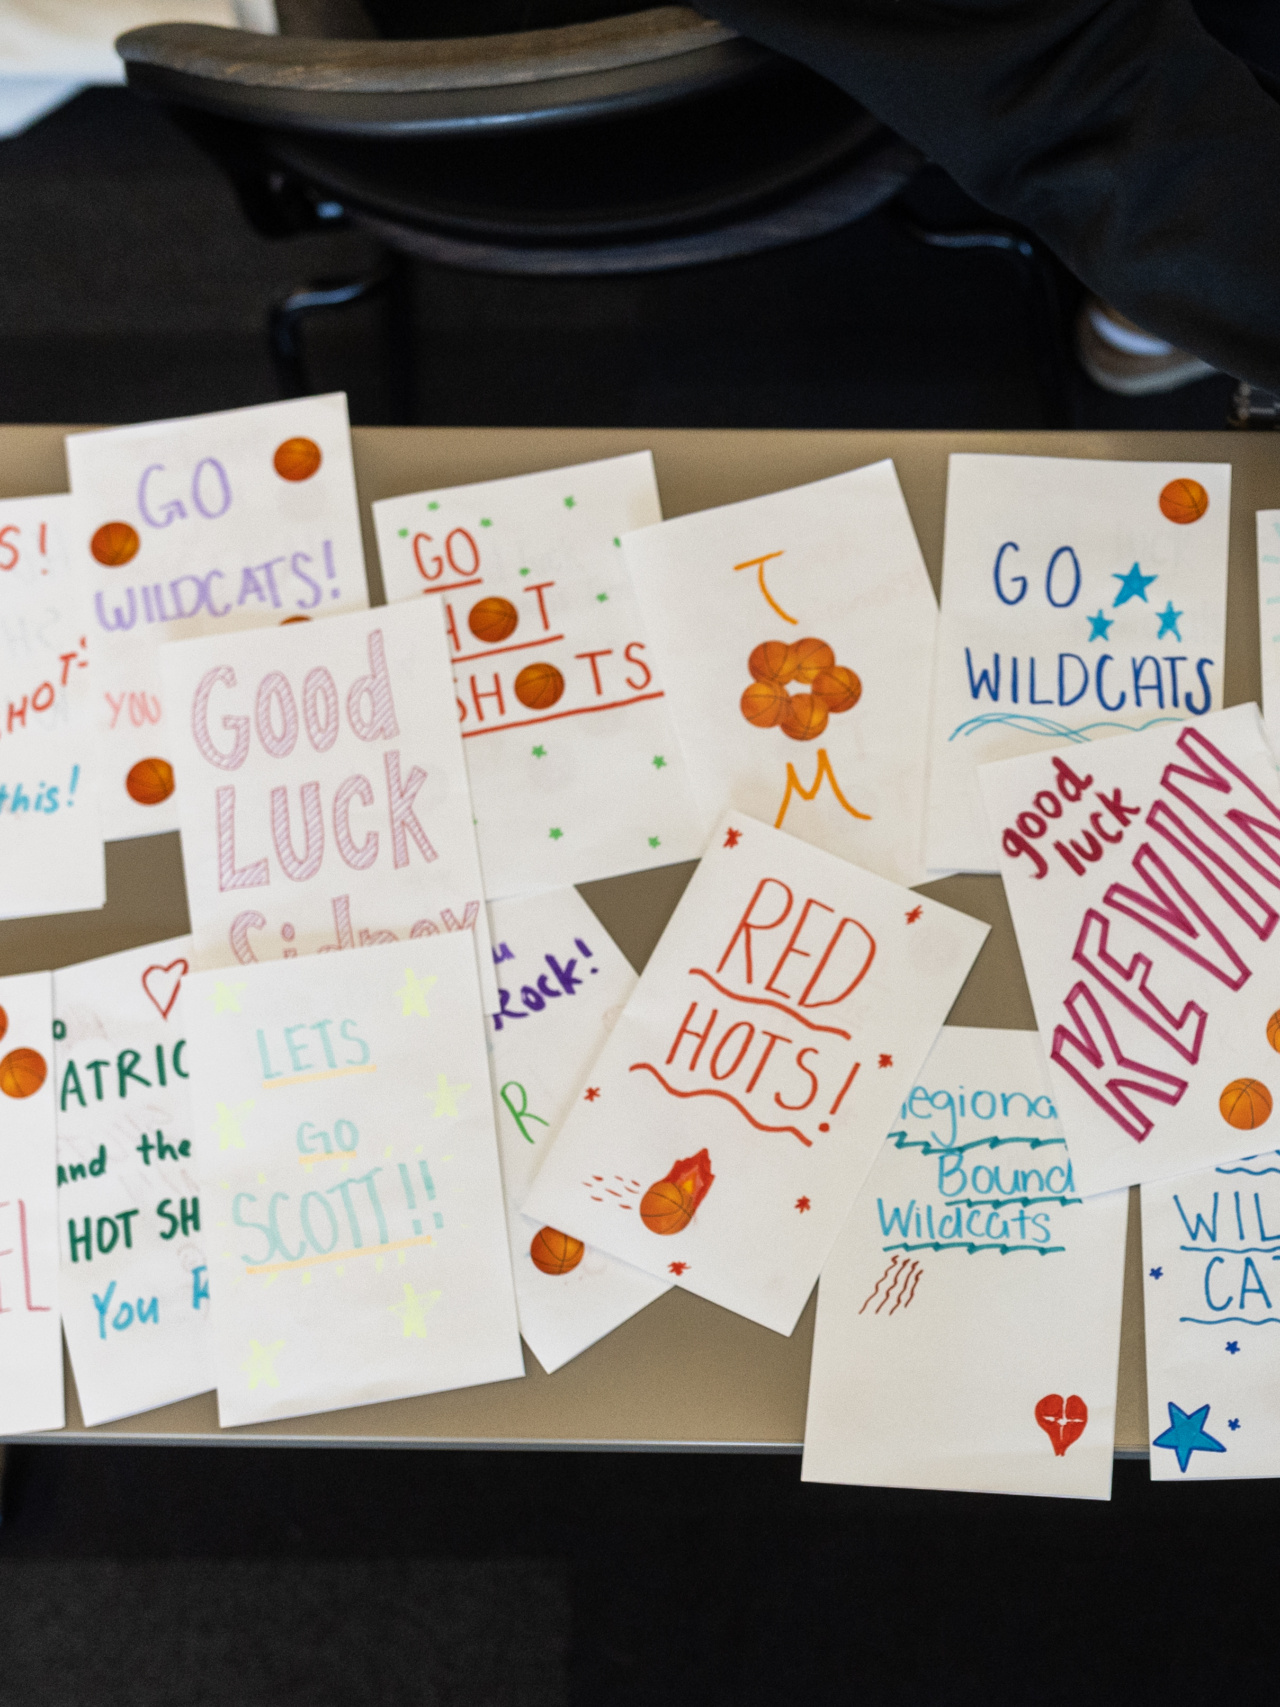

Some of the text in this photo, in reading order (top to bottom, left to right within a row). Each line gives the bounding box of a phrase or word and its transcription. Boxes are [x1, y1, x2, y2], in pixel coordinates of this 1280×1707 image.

[137, 456, 233, 528] GO
[94, 540, 342, 632] WILDCATS!
[412, 527, 481, 581] GO
[993, 541, 1082, 608] GO
[964, 646, 1215, 716] WILDCATS
[1001, 756, 1094, 880] good
[1053, 787, 1142, 877] luck
[716, 877, 877, 1008] RED
[60, 1038, 190, 1112] ATRIC
[255, 1018, 372, 1082] LETS
[665, 1001, 861, 1133] HOTS!
[136, 1129, 191, 1166] the
[296, 1118, 361, 1154] GO
[938, 1151, 1076, 1198] Bound
[68, 1208, 140, 1264] HOT
[231, 1160, 445, 1267] SCOTT!!
[876, 1197, 1052, 1244] Wildcats
[92, 1280, 160, 1341] You
